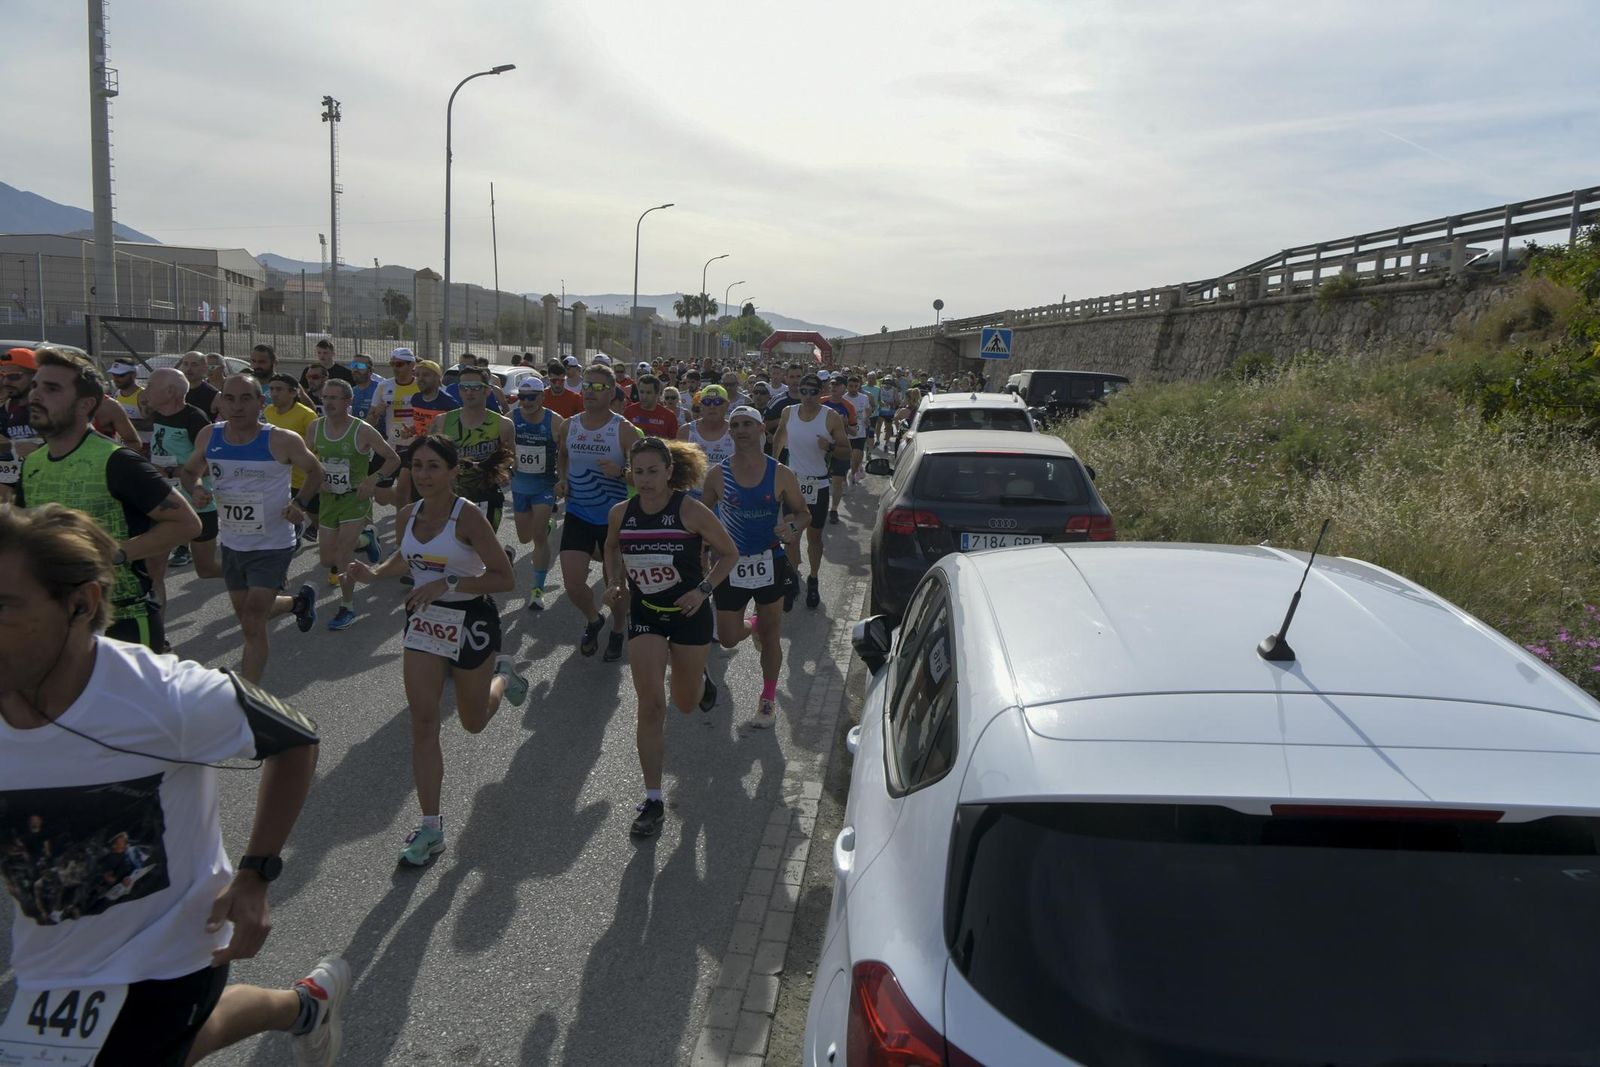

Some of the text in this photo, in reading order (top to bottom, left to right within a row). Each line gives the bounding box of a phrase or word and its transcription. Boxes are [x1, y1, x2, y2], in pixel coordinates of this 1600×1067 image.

[520, 454, 540, 465] 661
[224, 505, 255, 520] 702
[972, 535, 1007, 549] 7184
[630, 566, 676, 585] 2159
[737, 562, 766, 578] 616
[412, 618, 458, 643] 2062
[27, 990, 106, 1039] 446
